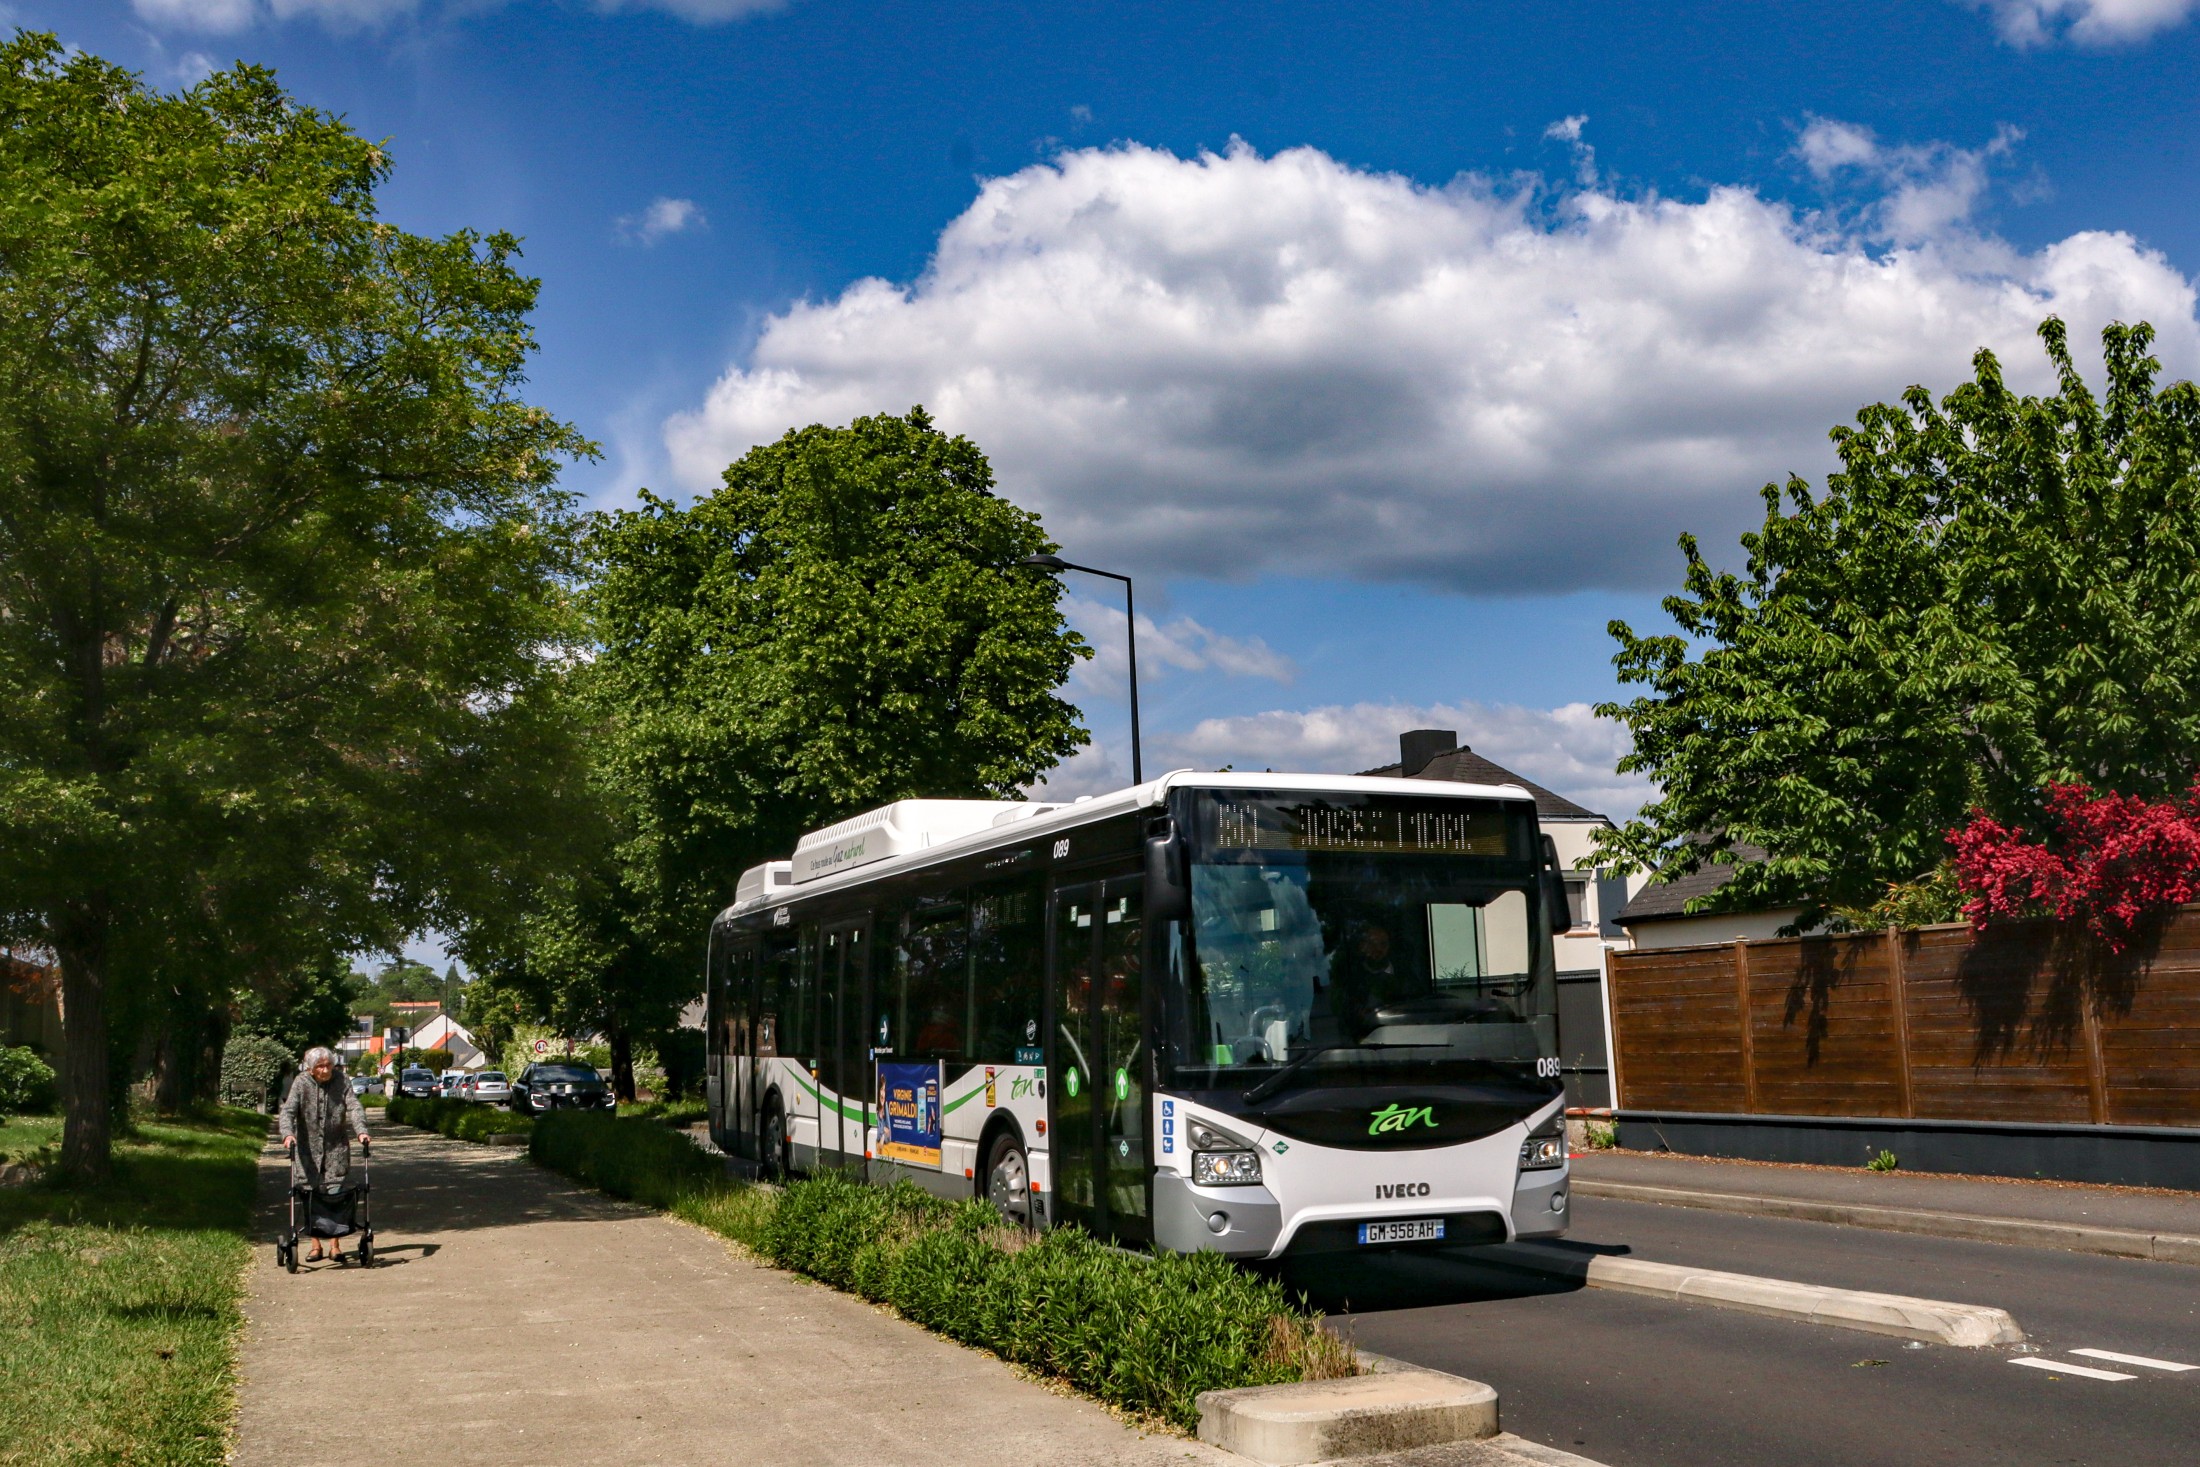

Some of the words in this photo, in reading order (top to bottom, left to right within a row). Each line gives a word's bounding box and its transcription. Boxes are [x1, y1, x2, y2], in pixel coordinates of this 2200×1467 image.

[1053, 838, 1070, 859] 089
[1537, 1057, 1560, 1078] 089
[893, 1088, 913, 1102] VIRGINIE
[1011, 1075, 1036, 1100] tan
[889, 1101, 918, 1119] GRIMALDI
[1368, 1103, 1440, 1136] tan
[1375, 1182, 1431, 1200] IVECO
[1369, 1221, 1434, 1241] GM-958-AH
